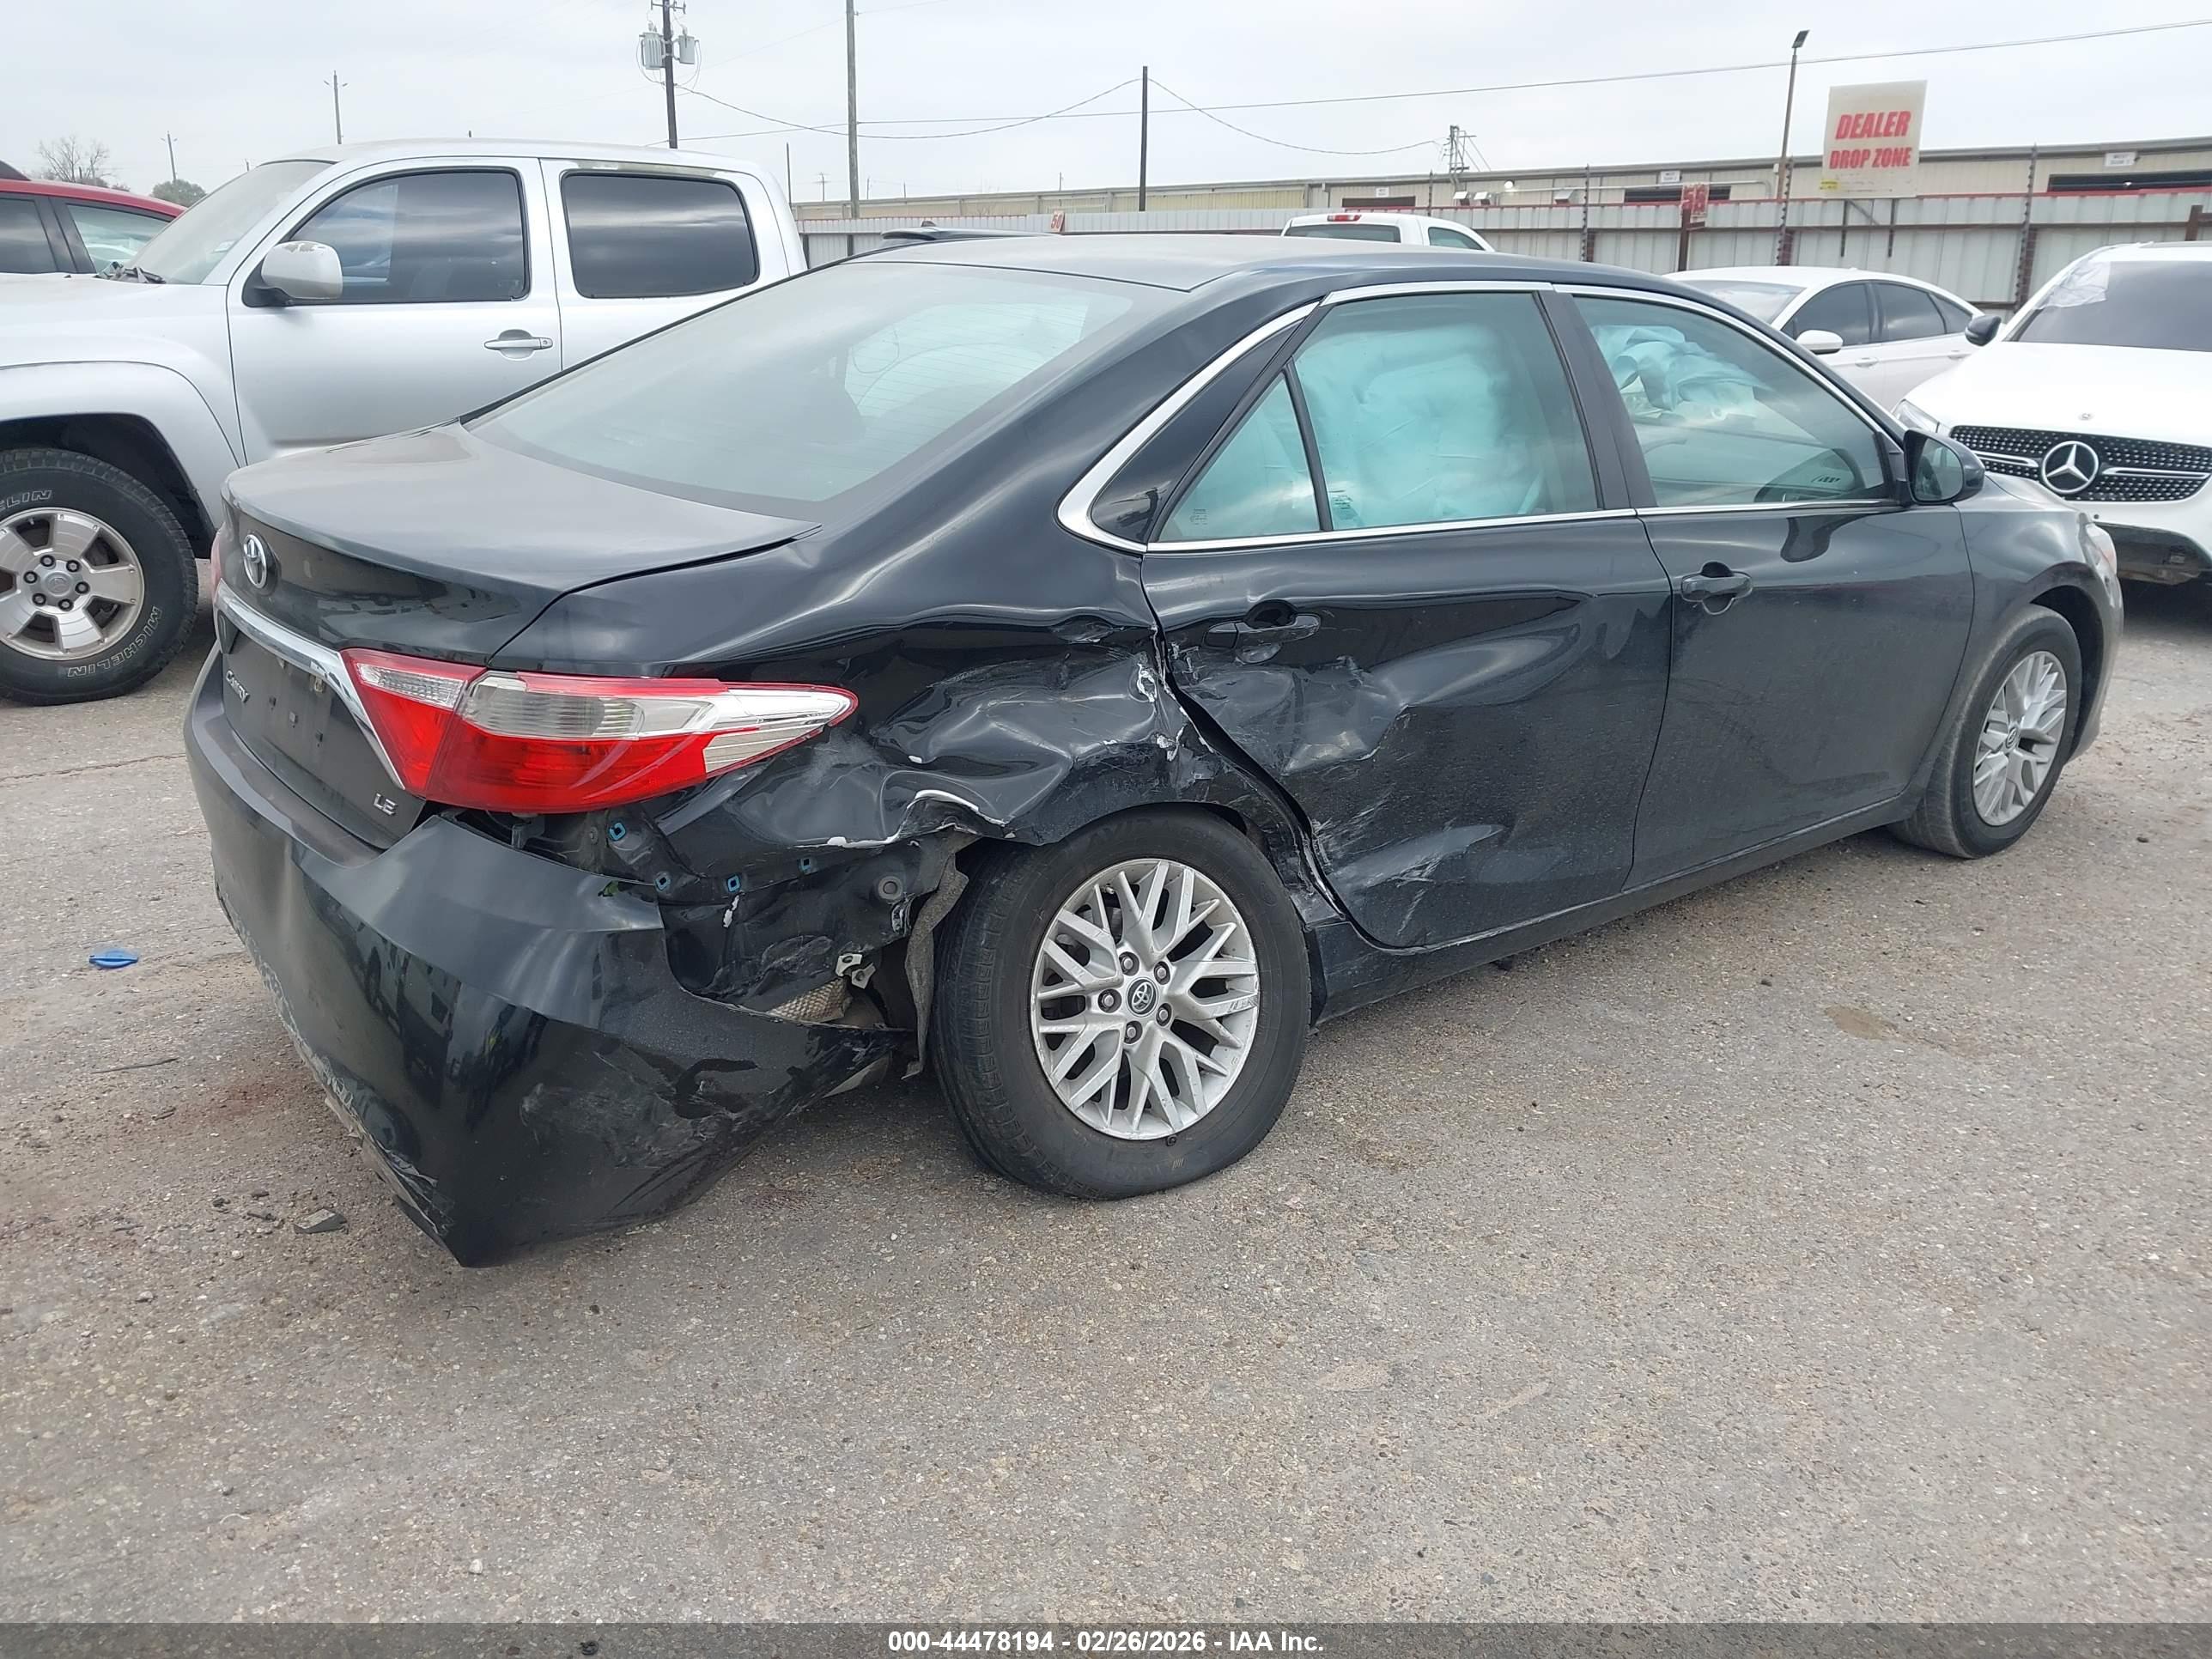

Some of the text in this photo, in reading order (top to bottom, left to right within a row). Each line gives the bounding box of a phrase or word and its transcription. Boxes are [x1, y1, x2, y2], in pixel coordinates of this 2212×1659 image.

[1834, 110, 1911, 140] DEALER
[1829, 147, 1912, 170] DROP ZONE
[68, 605, 162, 678] MICHELIN
[374, 793, 397, 816] LE
